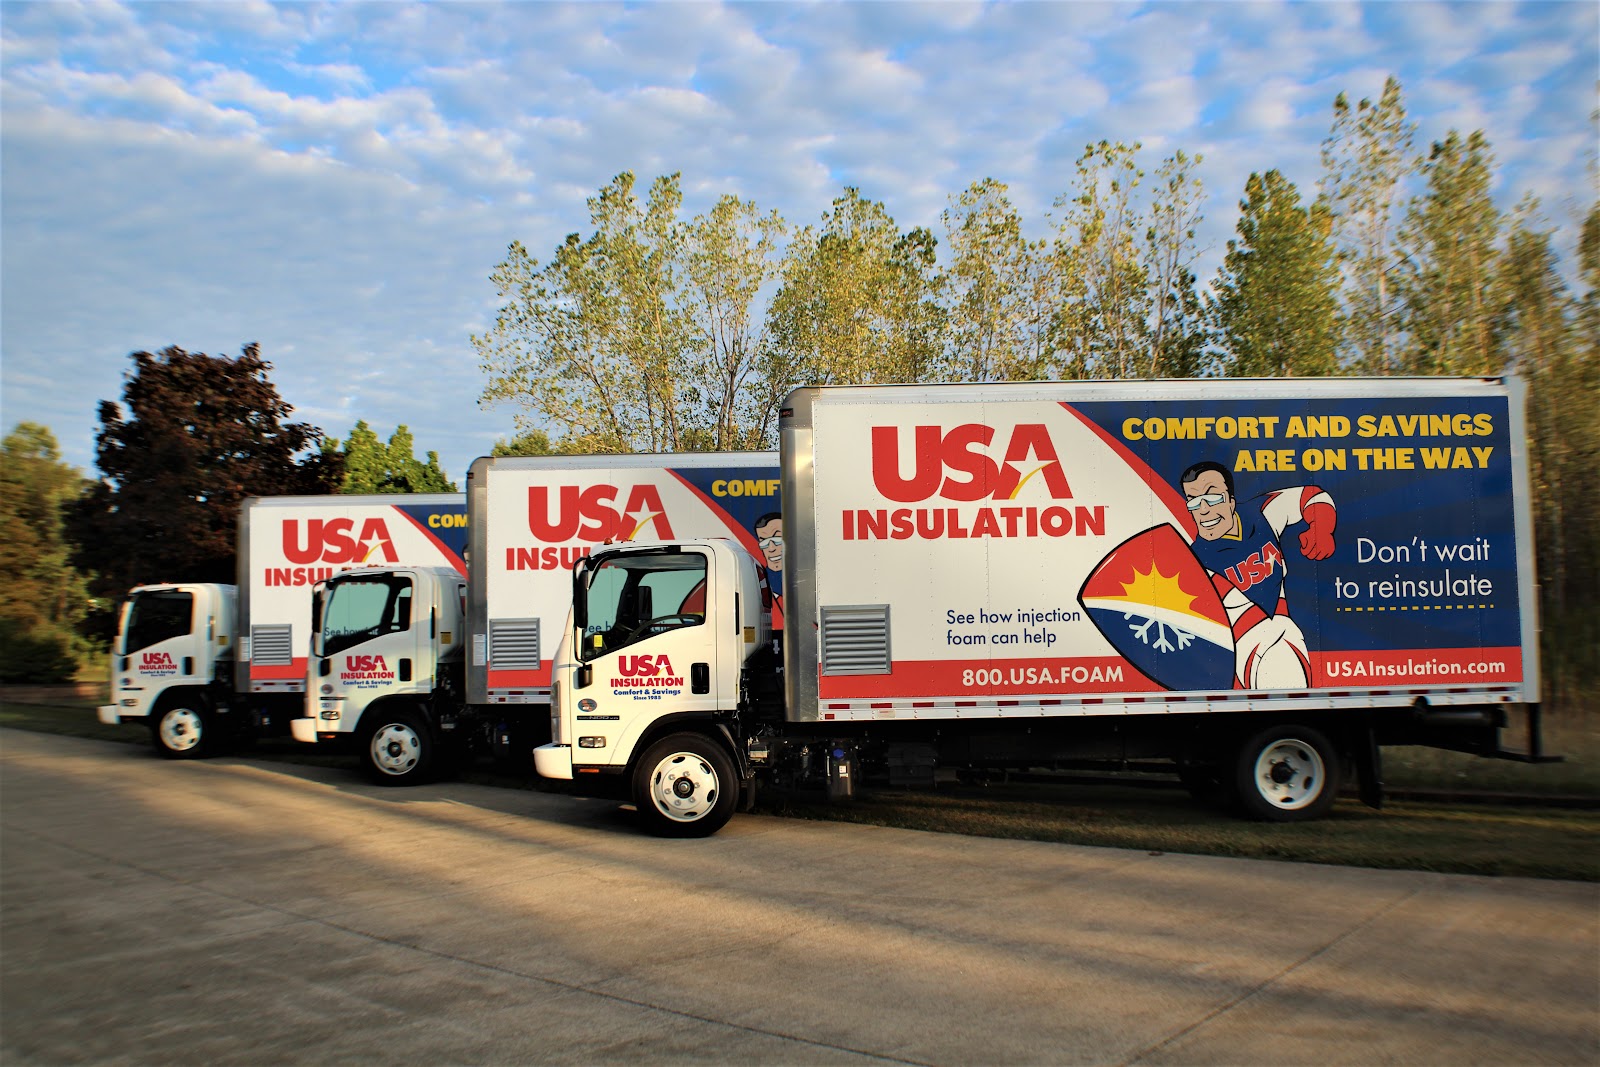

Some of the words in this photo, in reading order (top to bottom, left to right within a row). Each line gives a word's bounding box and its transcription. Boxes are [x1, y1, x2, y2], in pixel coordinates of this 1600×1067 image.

[1123, 417, 1280, 440] COMFORT
[1286, 416, 1351, 438] AND
[1358, 414, 1494, 437] SAVINGS
[872, 423, 1074, 503] USA
[1235, 449, 1296, 472] ARE
[1302, 449, 1347, 471] ON
[1353, 448, 1415, 470] THE
[1420, 447, 1494, 469] WAY
[711, 479, 781, 497] COMF
[528, 484, 675, 542] USA
[842, 505, 1106, 541] INSULATION
[282, 518, 400, 564] USA
[1358, 537, 1428, 563] Don't
[1435, 538, 1490, 562] wait
[1224, 541, 1283, 592] USA
[1335, 577, 1360, 599] to
[1370, 569, 1492, 598] reinsulate
[946, 609, 975, 624] See
[980, 608, 1013, 624] how
[1017, 608, 1081, 627] injection
[946, 630, 986, 645] foam
[991, 634, 1019, 645] can
[1024, 628, 1057, 647] help
[143, 653, 172, 664] USA
[346, 655, 387, 671] USA
[618, 654, 675, 677] USA
[1326, 659, 1506, 677] USAInsulation.com
[610, 677, 684, 687] INSULATION
[961, 666, 1124, 686] 800.USA.FOAM
[652, 688, 681, 696] Savings
